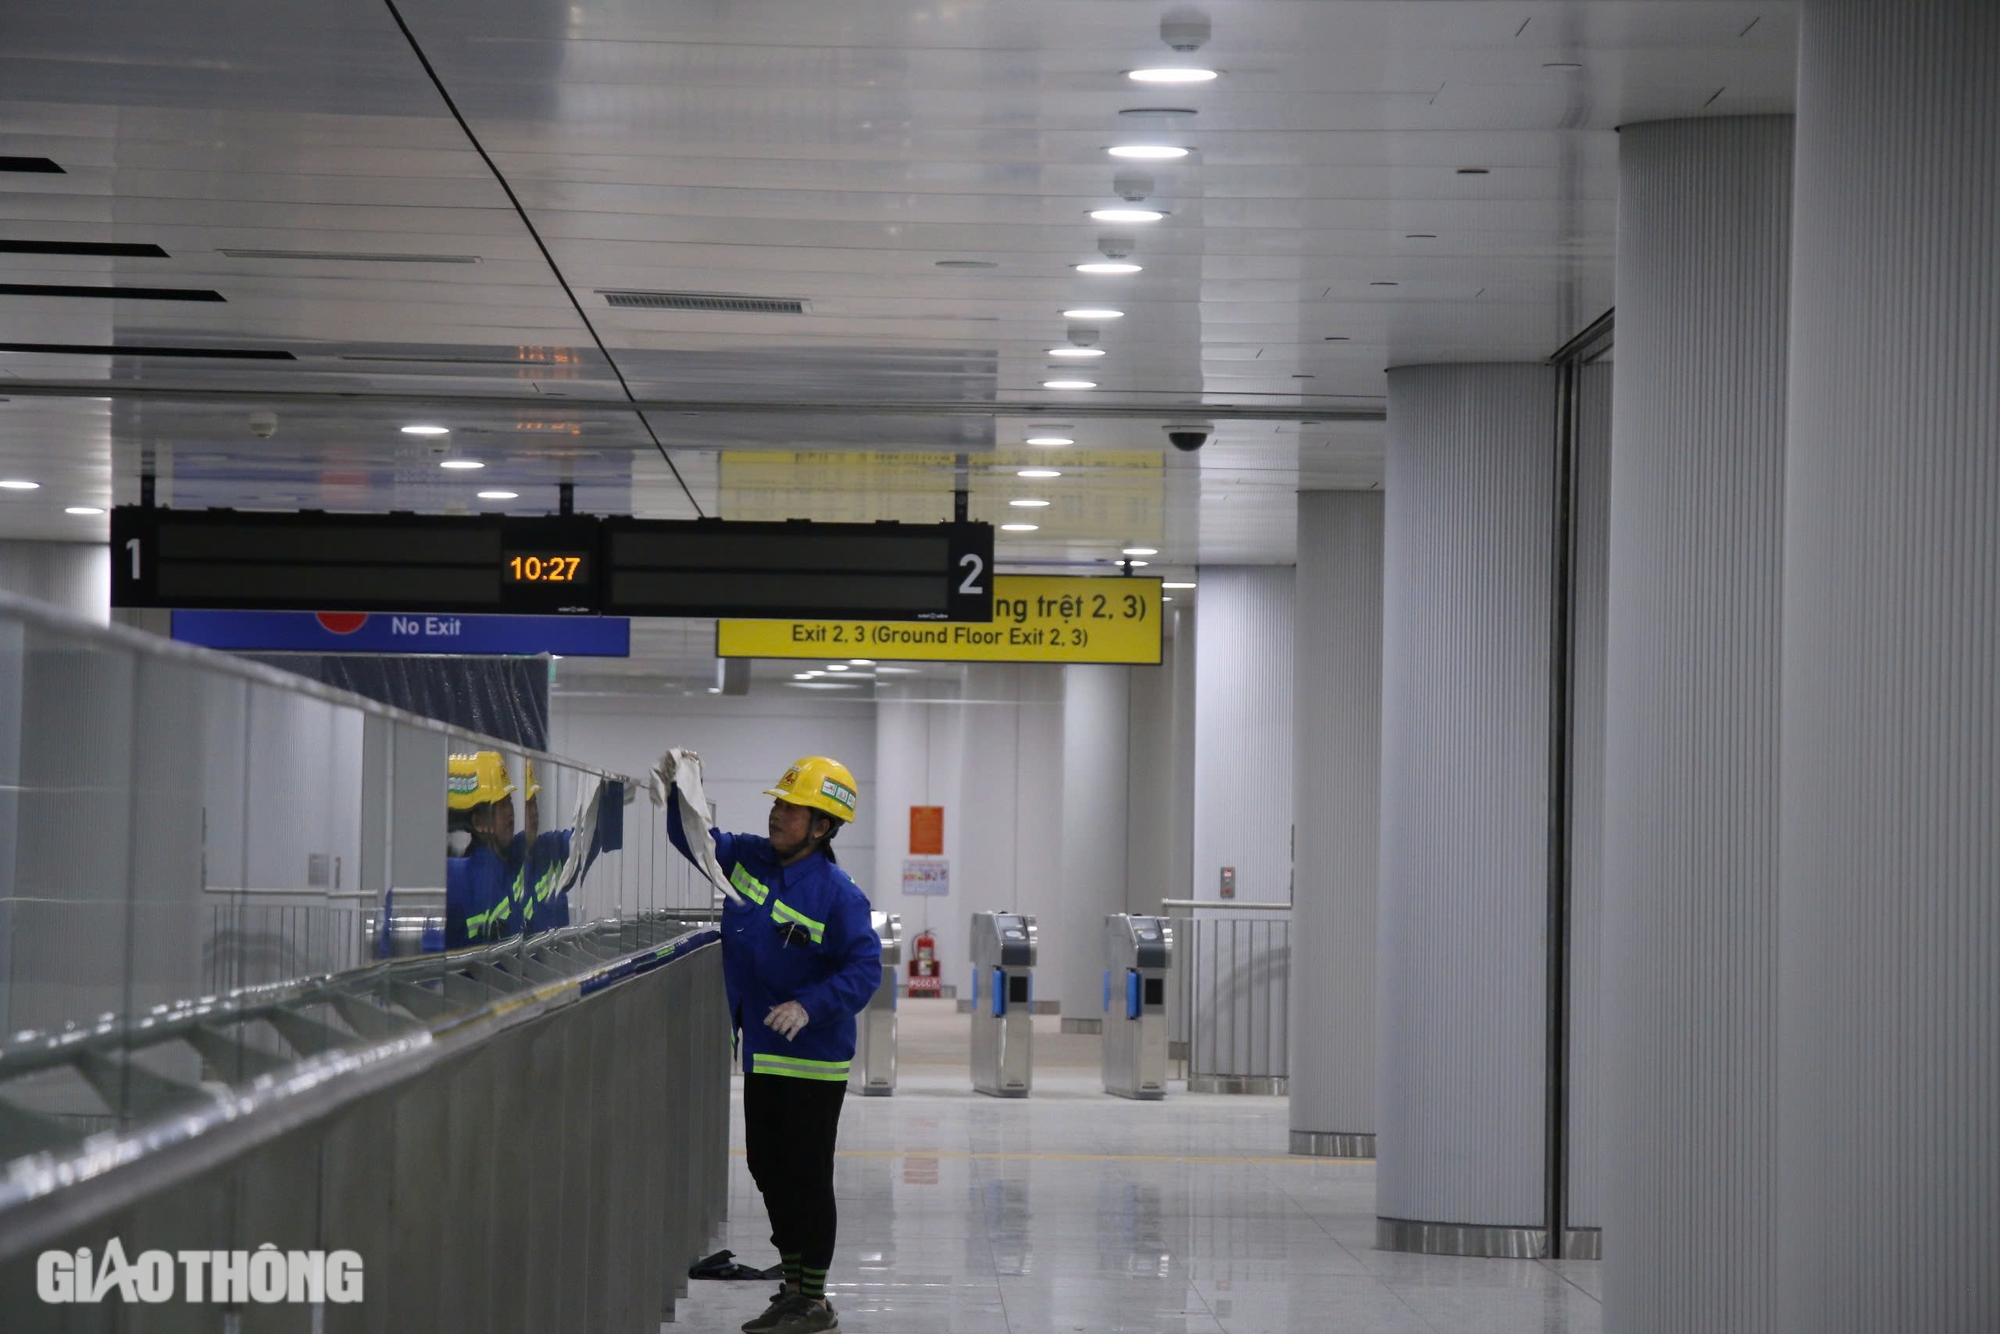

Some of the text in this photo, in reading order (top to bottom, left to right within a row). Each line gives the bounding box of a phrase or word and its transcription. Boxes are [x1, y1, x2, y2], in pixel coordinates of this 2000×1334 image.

[126, 538, 140, 580] 1
[510, 556, 581, 581] 10:27
[959, 553, 983, 594] 2
[996, 594, 1146, 624] ng trệt 2, 3)
[392, 616, 461, 635] No Exit
[793, 624, 1088, 648] Exit 2, 3 (Ground Floor Exit 2, 3)
